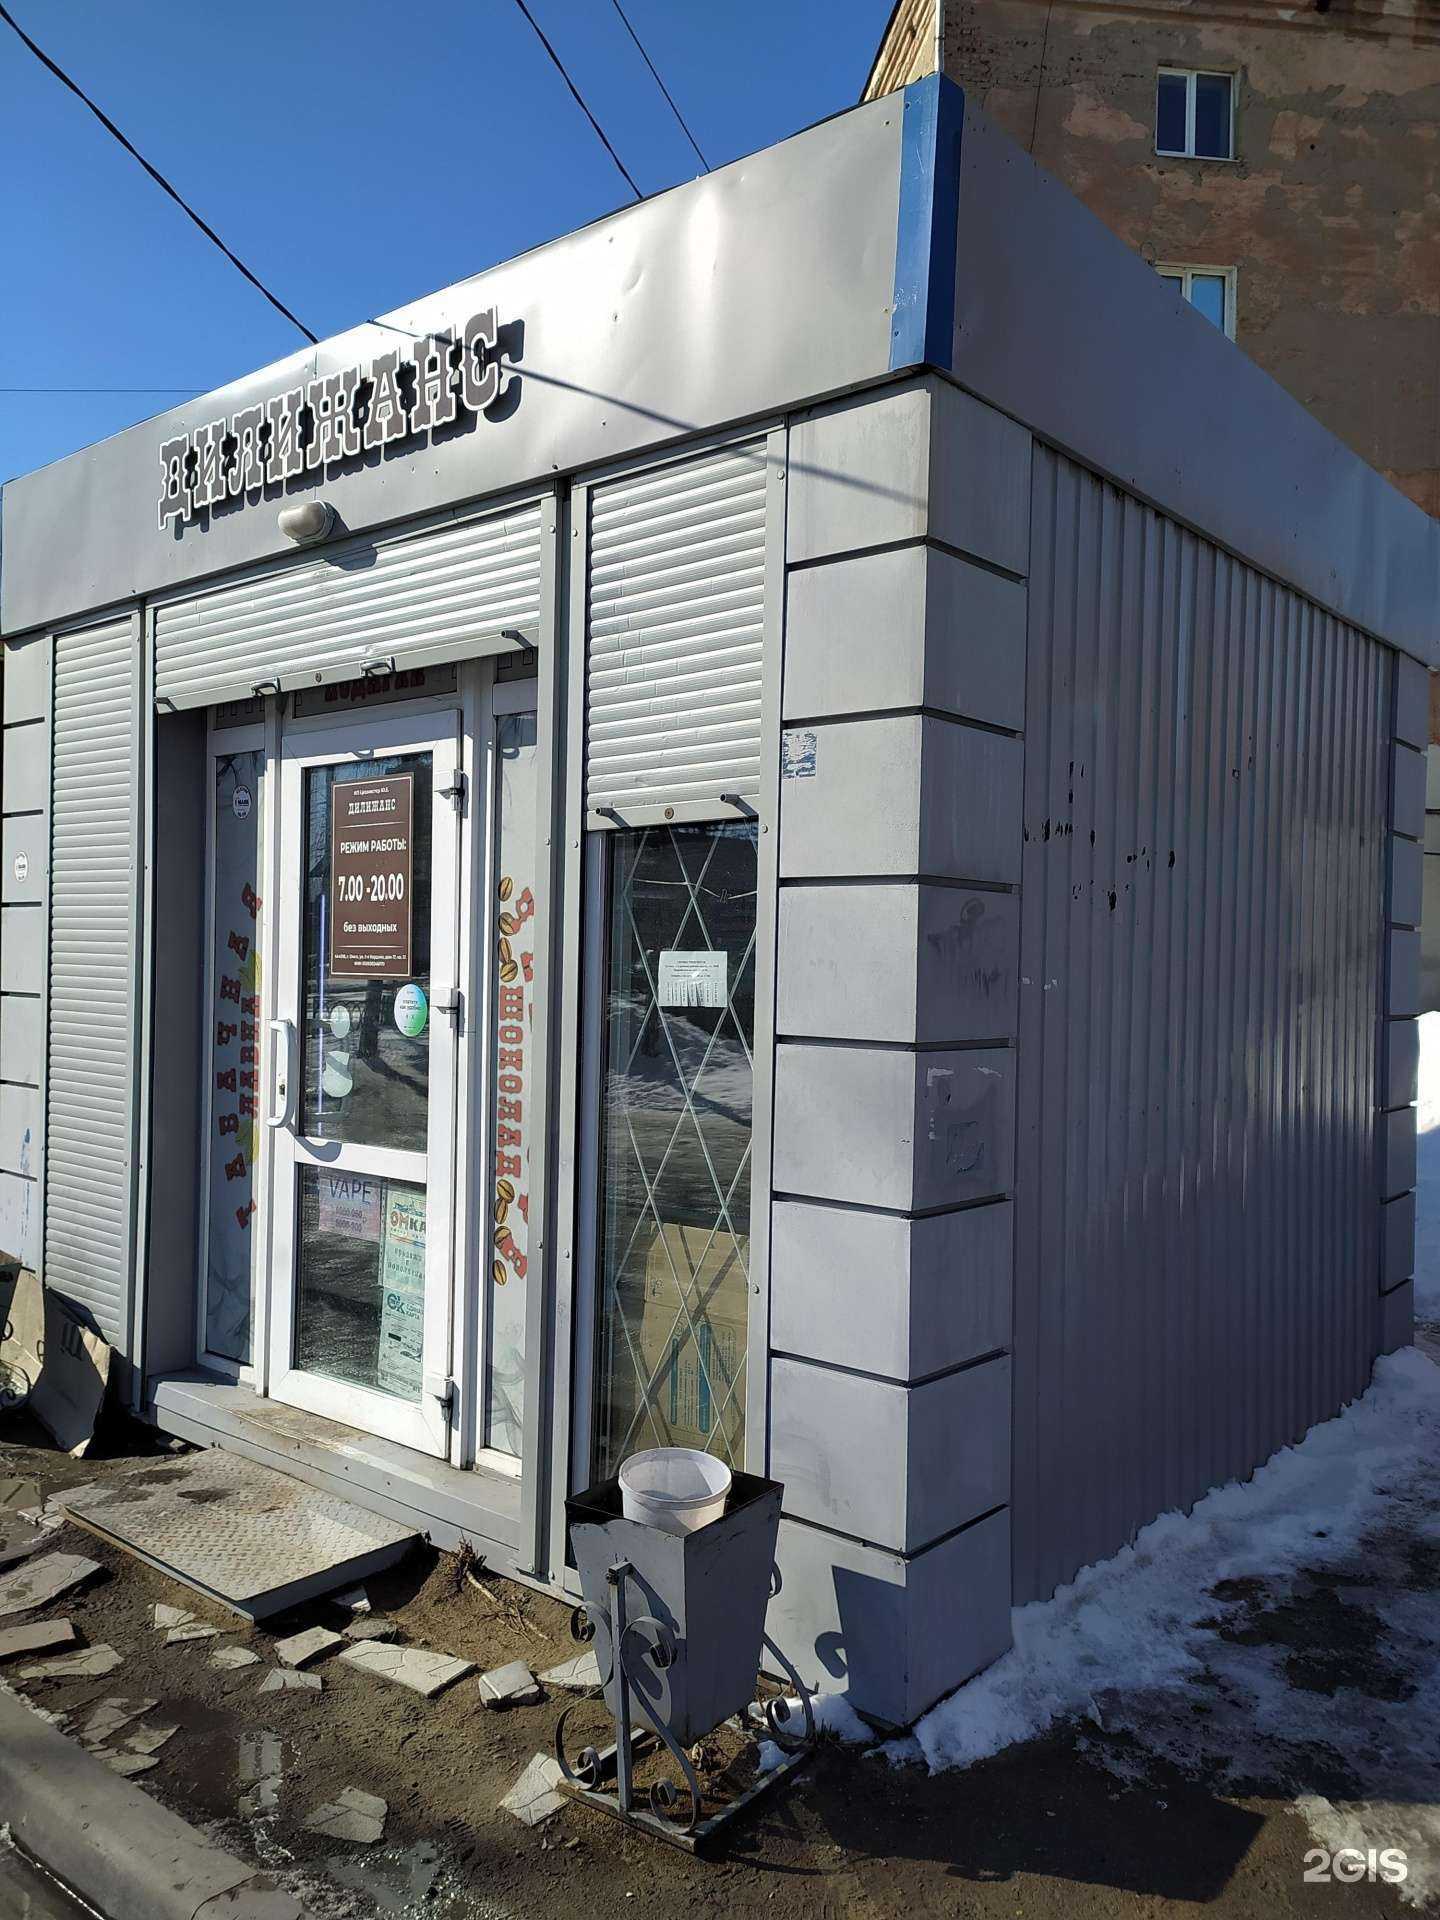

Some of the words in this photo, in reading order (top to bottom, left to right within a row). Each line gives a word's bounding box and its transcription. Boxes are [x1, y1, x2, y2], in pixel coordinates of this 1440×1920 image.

[158, 304, 499, 531] ДИЛИЖАНС
[348, 798, 396, 815] ДИЛИЖАНС
[340, 841, 369, 854] РЕЖИМ
[371, 838, 407, 852] РАБОТЫ:
[343, 921, 357, 932] без
[358, 923, 398, 934] выходных
[495, 984, 524, 1179] ШОКОЛАД
[329, 1177, 372, 1204] VAPE
